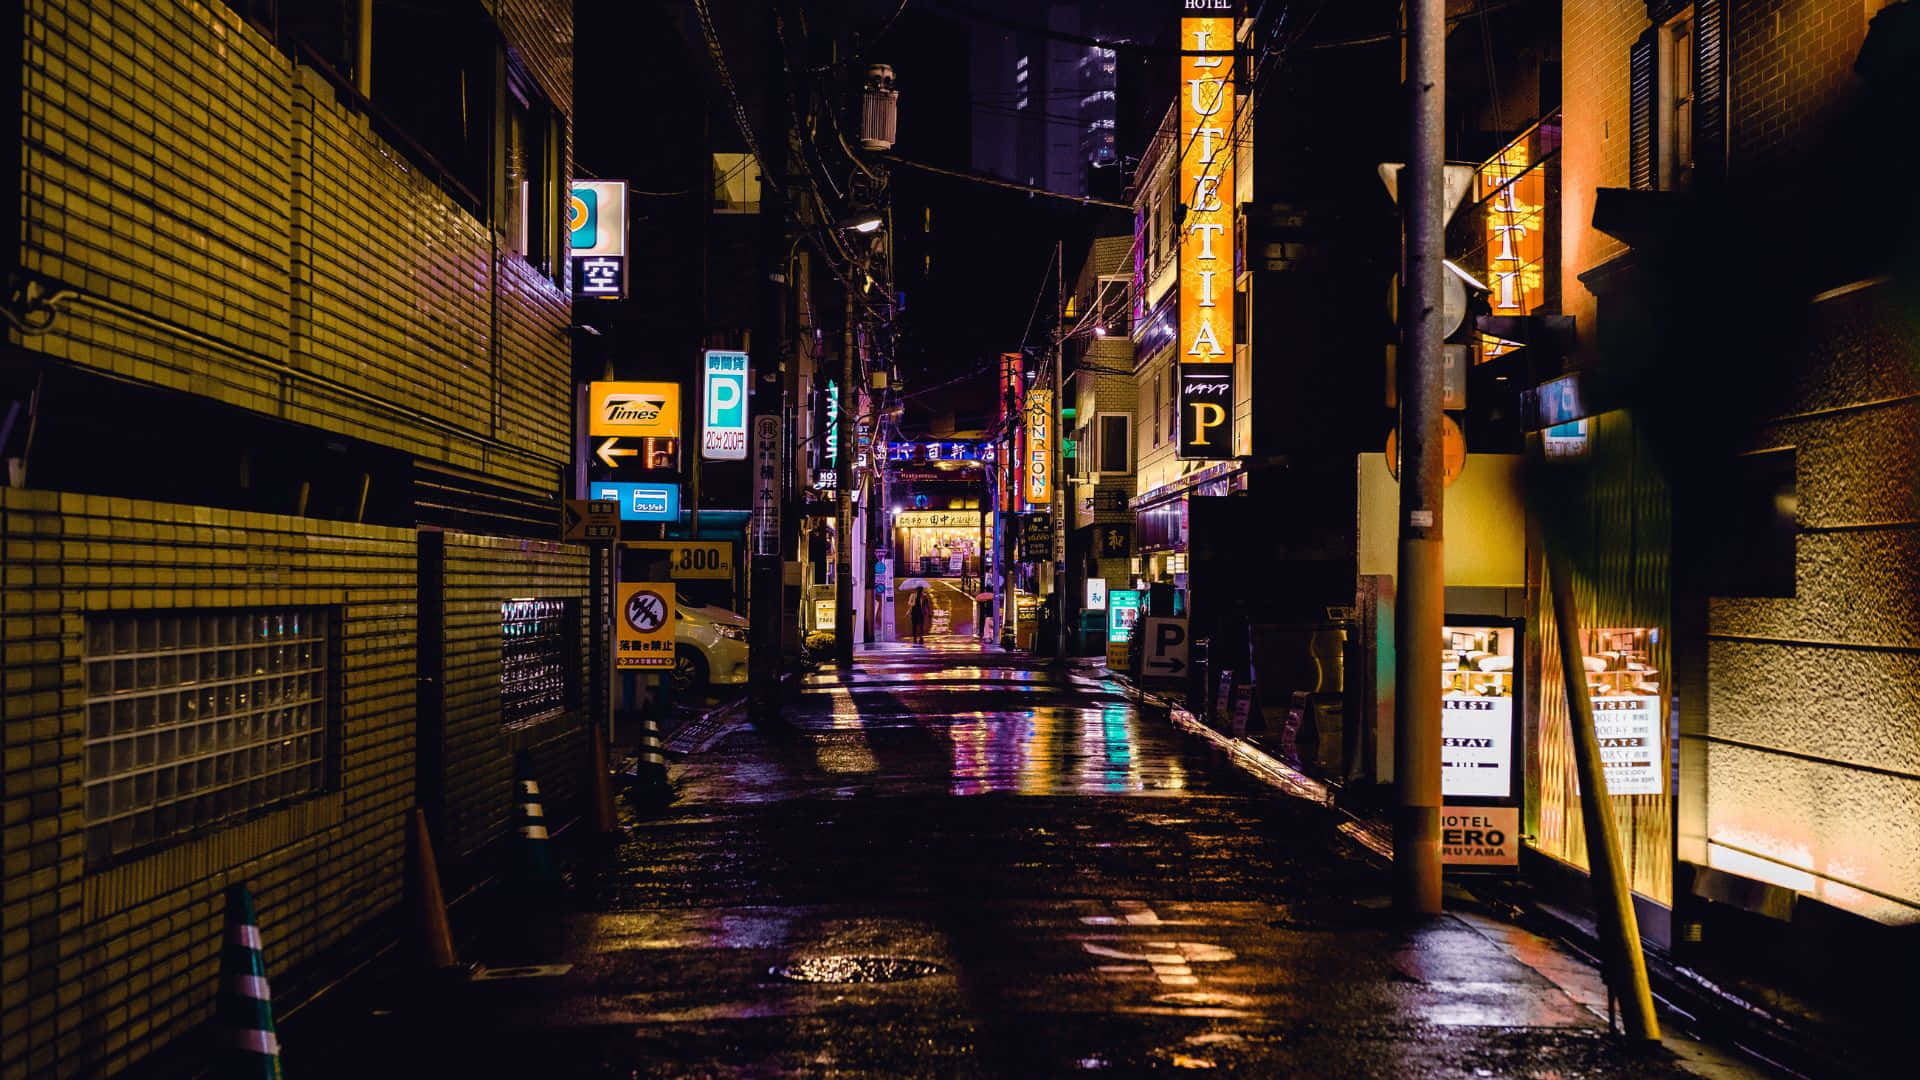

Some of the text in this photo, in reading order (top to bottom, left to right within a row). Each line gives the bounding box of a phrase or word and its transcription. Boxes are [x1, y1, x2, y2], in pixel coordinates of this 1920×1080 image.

[1185, 0, 1232, 9] HOTEL
[1188, 31, 1225, 356] LUTETIA
[583, 258, 619, 293] 空
[709, 356, 744, 370] 時間貸
[606, 400, 666, 420] Times
[710, 378, 740, 424] P
[1189, 402, 1226, 446] P
[1156, 624, 1185, 657] P
[1446, 701, 1489, 710] REST
[1446, 739, 1488, 747] STAY
